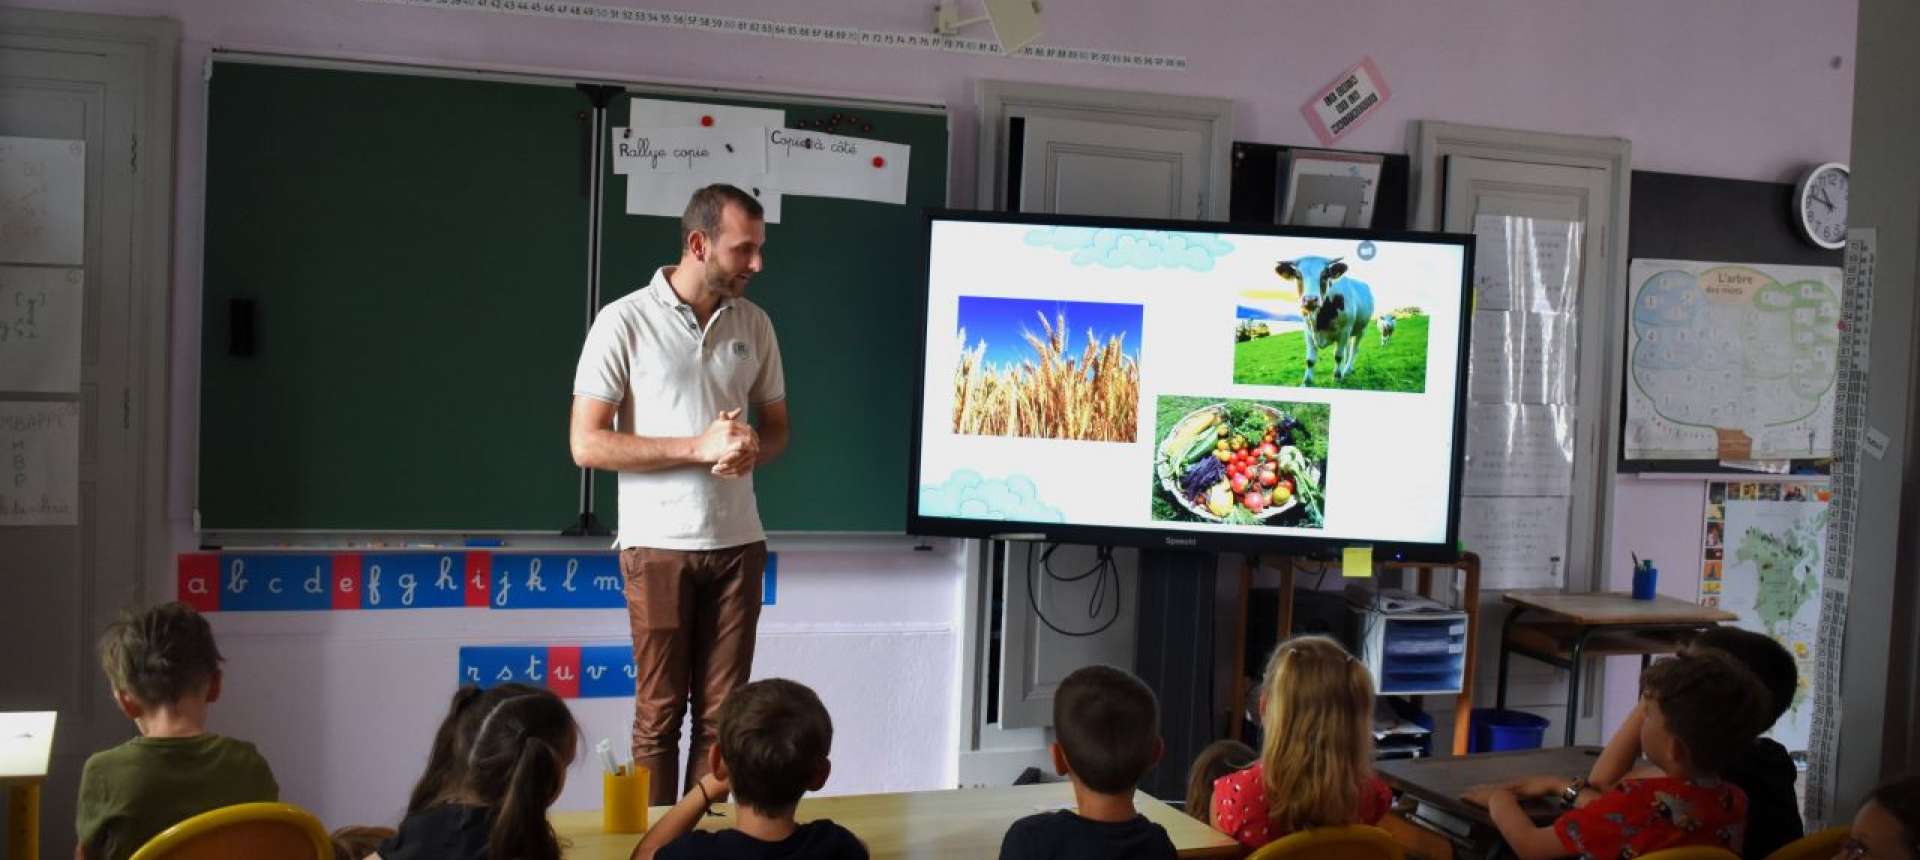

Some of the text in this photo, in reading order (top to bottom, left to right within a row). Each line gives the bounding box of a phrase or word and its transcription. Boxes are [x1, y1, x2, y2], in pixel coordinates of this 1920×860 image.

[619, 137, 711, 169] Rallye copie
[1717, 272, 1753, 285] L'arbre
[187, 556, 621, 606] a b c d e f g h i j k l m
[467, 665, 481, 682] r
[495, 665, 514, 681] s
[526, 653, 544, 681] t
[554, 665, 576, 681] u
[586, 665, 608, 680] v
